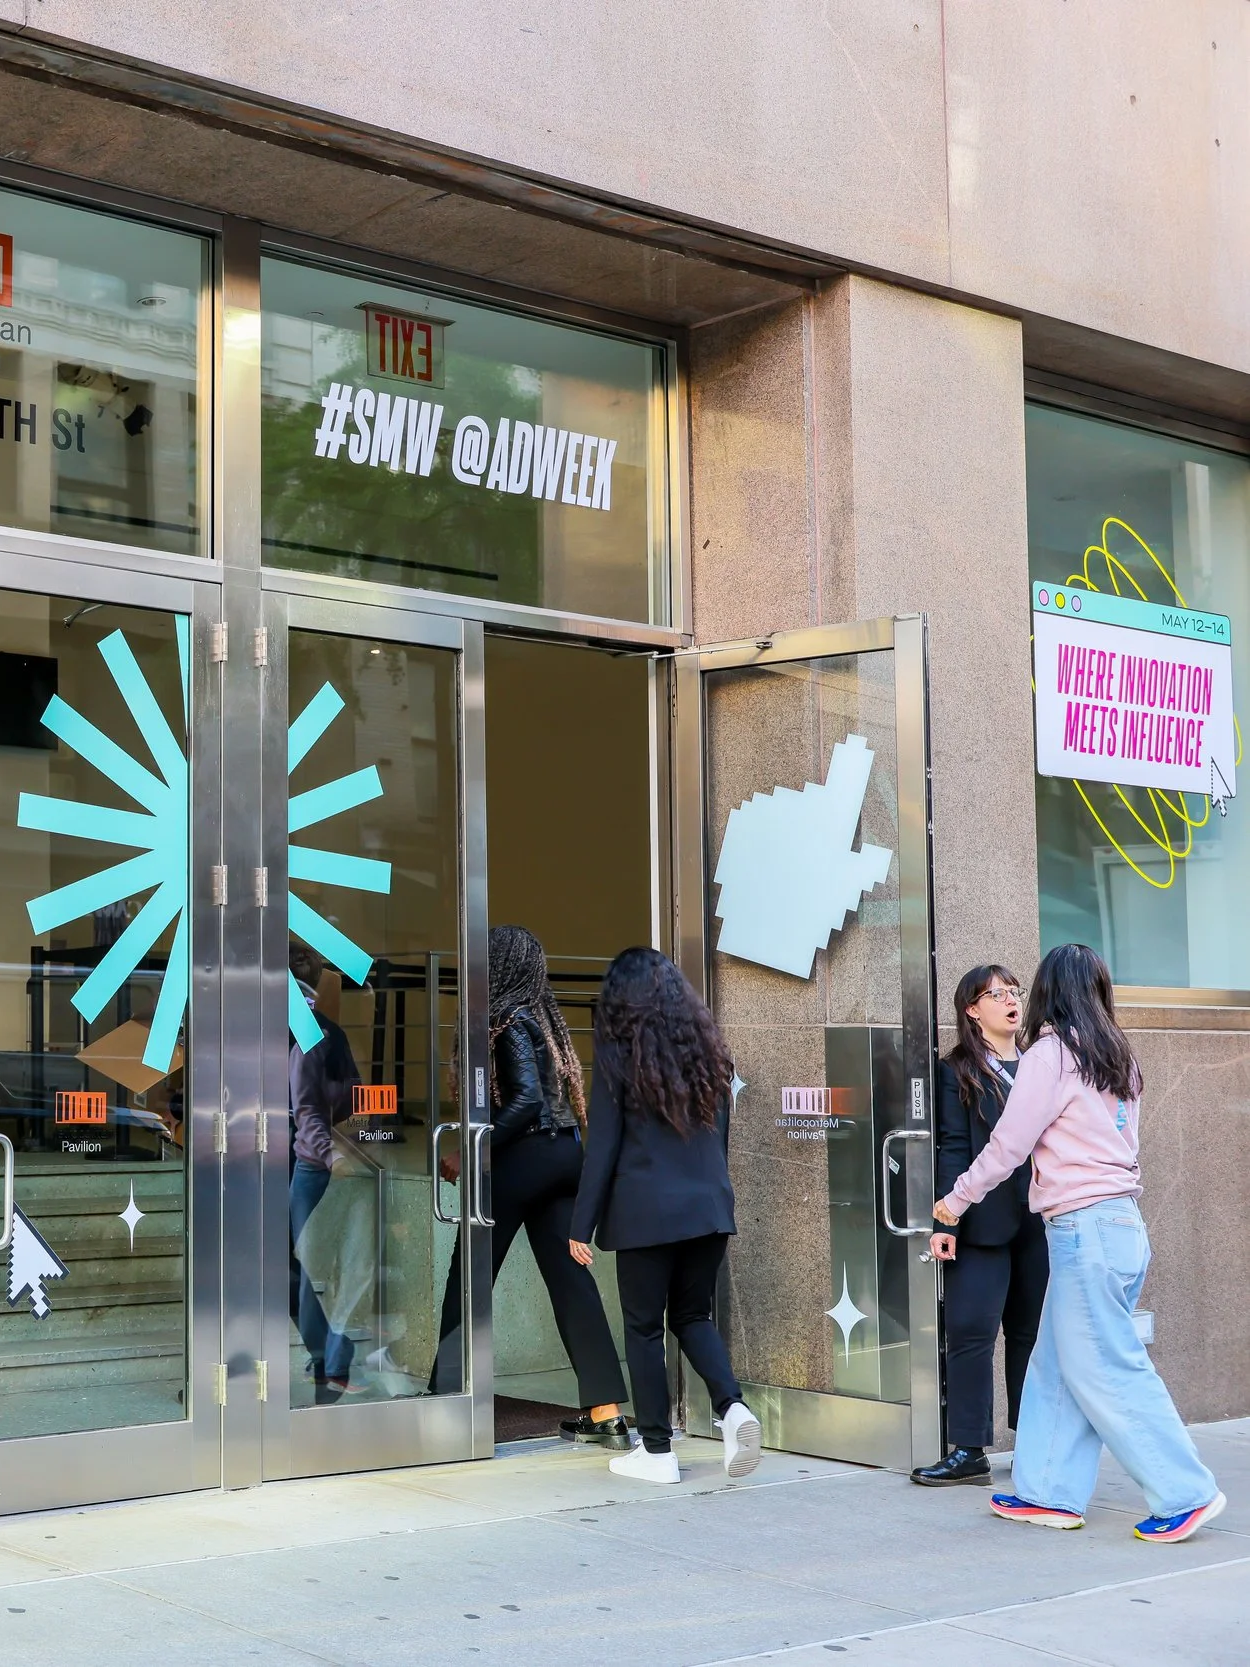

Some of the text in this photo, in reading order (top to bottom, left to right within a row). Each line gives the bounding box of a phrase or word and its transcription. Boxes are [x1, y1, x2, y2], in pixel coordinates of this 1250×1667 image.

[51, 407, 86, 453] St
[314, 382, 618, 511] #SMW @ADWEEK
[1161, 613, 1189, 630] MAY
[1057, 643, 1213, 716] WHERE INNOVATION
[1063, 701, 1204, 768] MEETS INFLUENCE
[914, 1081, 922, 1117] PUSH
[61, 1140, 102, 1153] Pavilion
[359, 1129, 394, 1141] Pavilion
